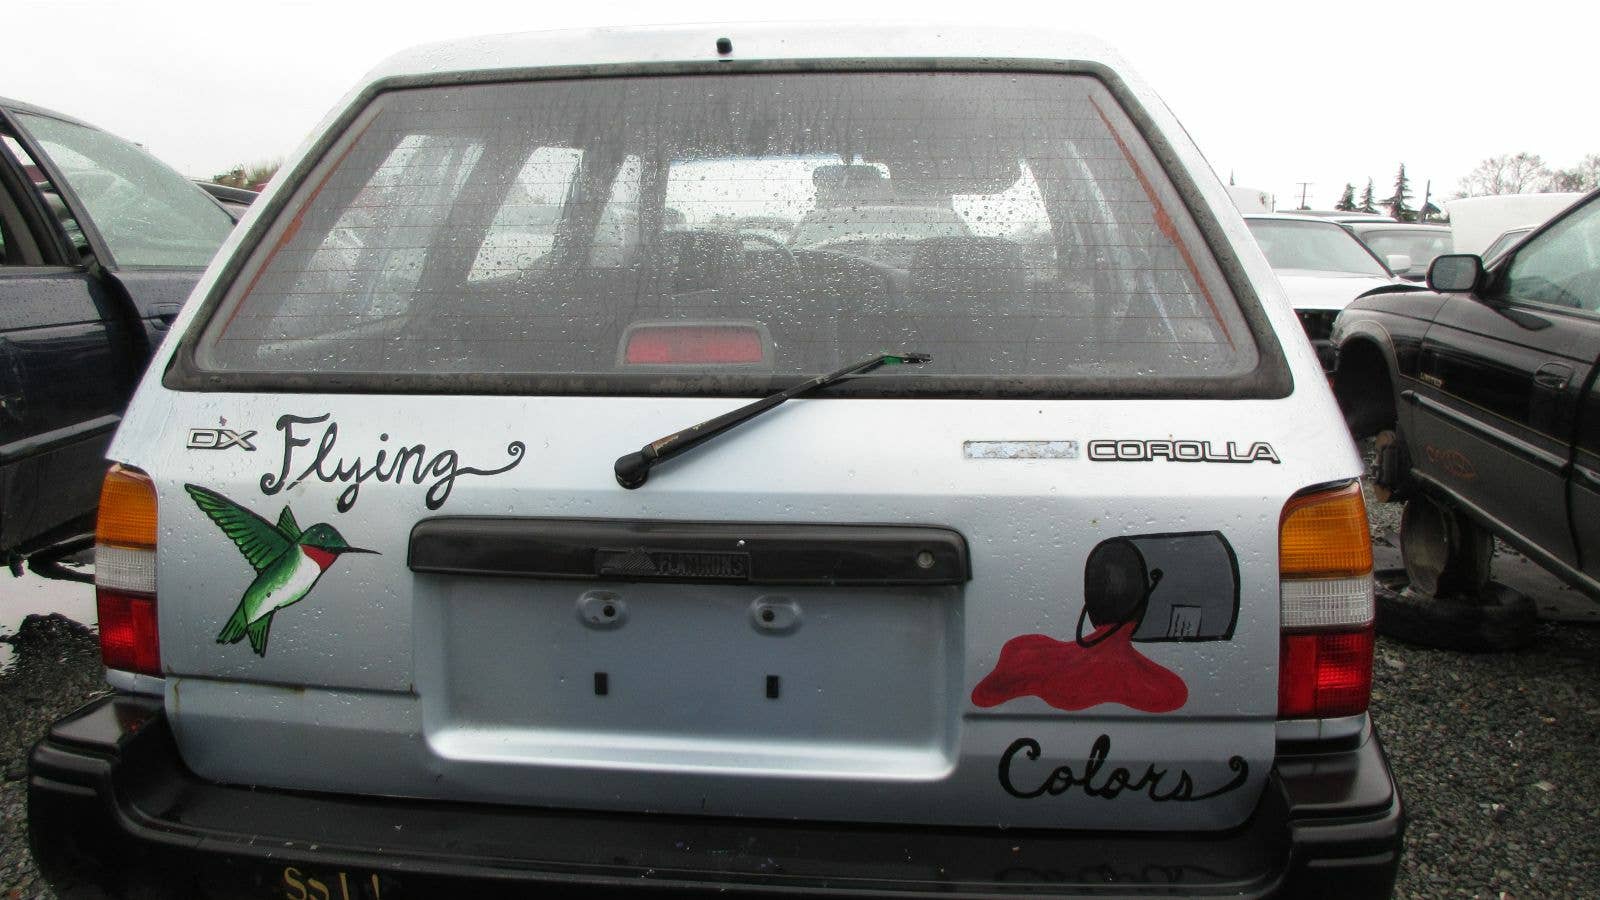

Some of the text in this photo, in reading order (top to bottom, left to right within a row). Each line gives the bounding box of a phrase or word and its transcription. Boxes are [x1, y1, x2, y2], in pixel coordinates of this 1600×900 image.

[186, 427, 258, 452] DX
[260, 412, 526, 514] Flying
[1087, 439, 1282, 464] COROLLA
[998, 733, 1250, 802] Colors
